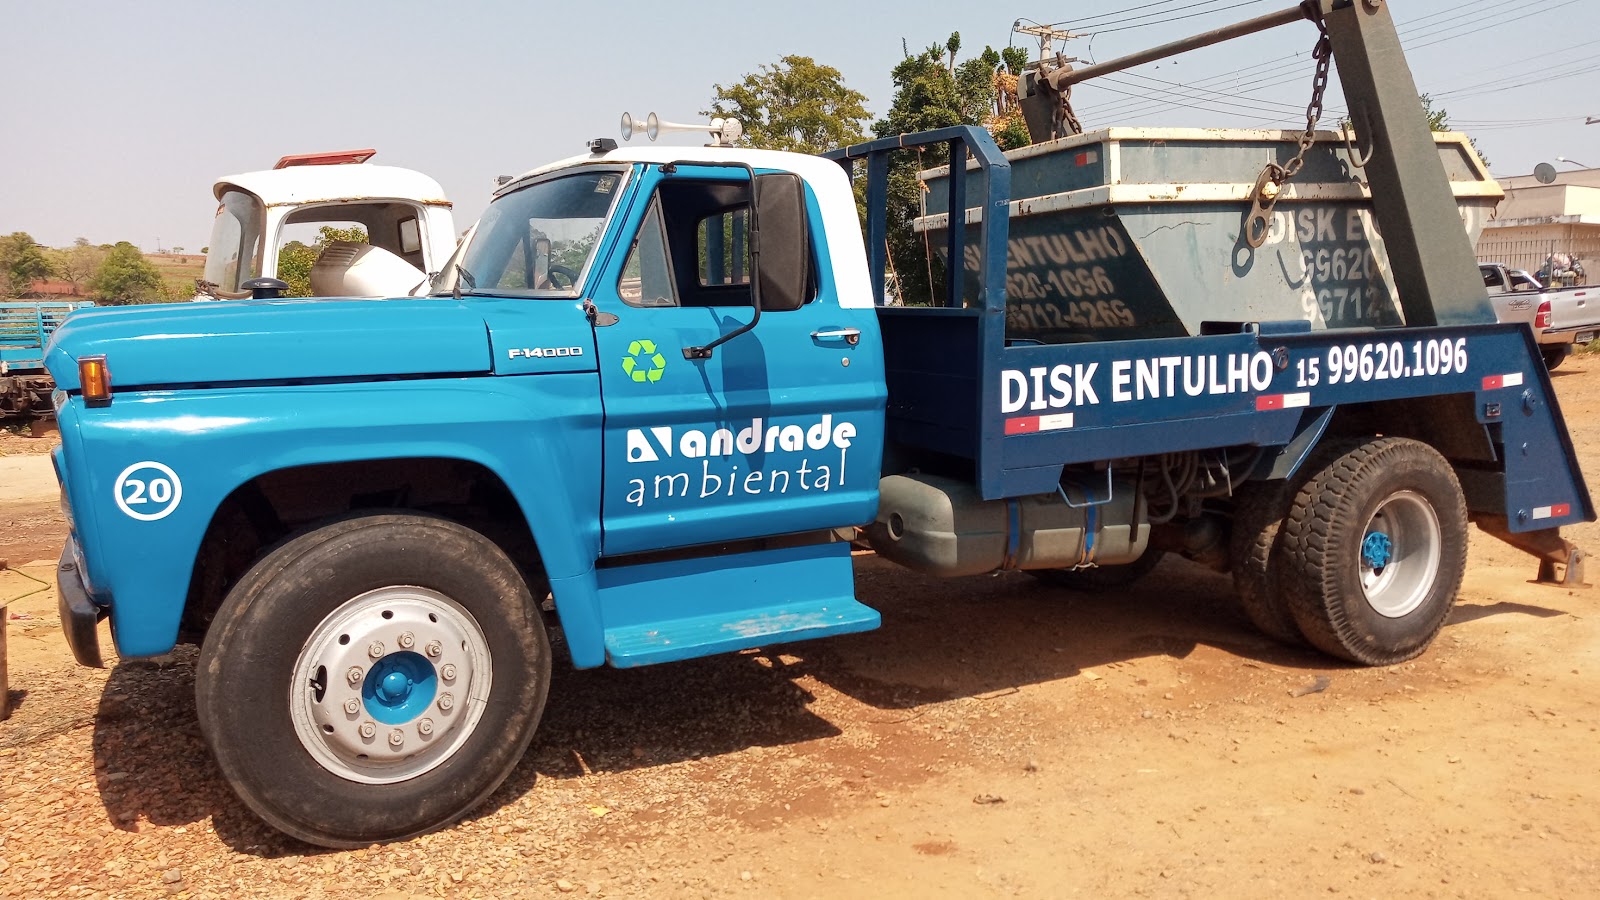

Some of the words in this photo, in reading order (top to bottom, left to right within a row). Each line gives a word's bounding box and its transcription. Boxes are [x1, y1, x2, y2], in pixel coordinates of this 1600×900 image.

[1267, 208, 1337, 244] DISK
[1001, 362, 1100, 414] DISK
[1112, 350, 1274, 402] ENTULHO
[1296, 357, 1320, 388] 15
[1327, 337, 1468, 385] 99620.1096
[679, 413, 857, 458] andrade
[125, 478, 172, 504] 20
[625, 447, 847, 507] ambiental
